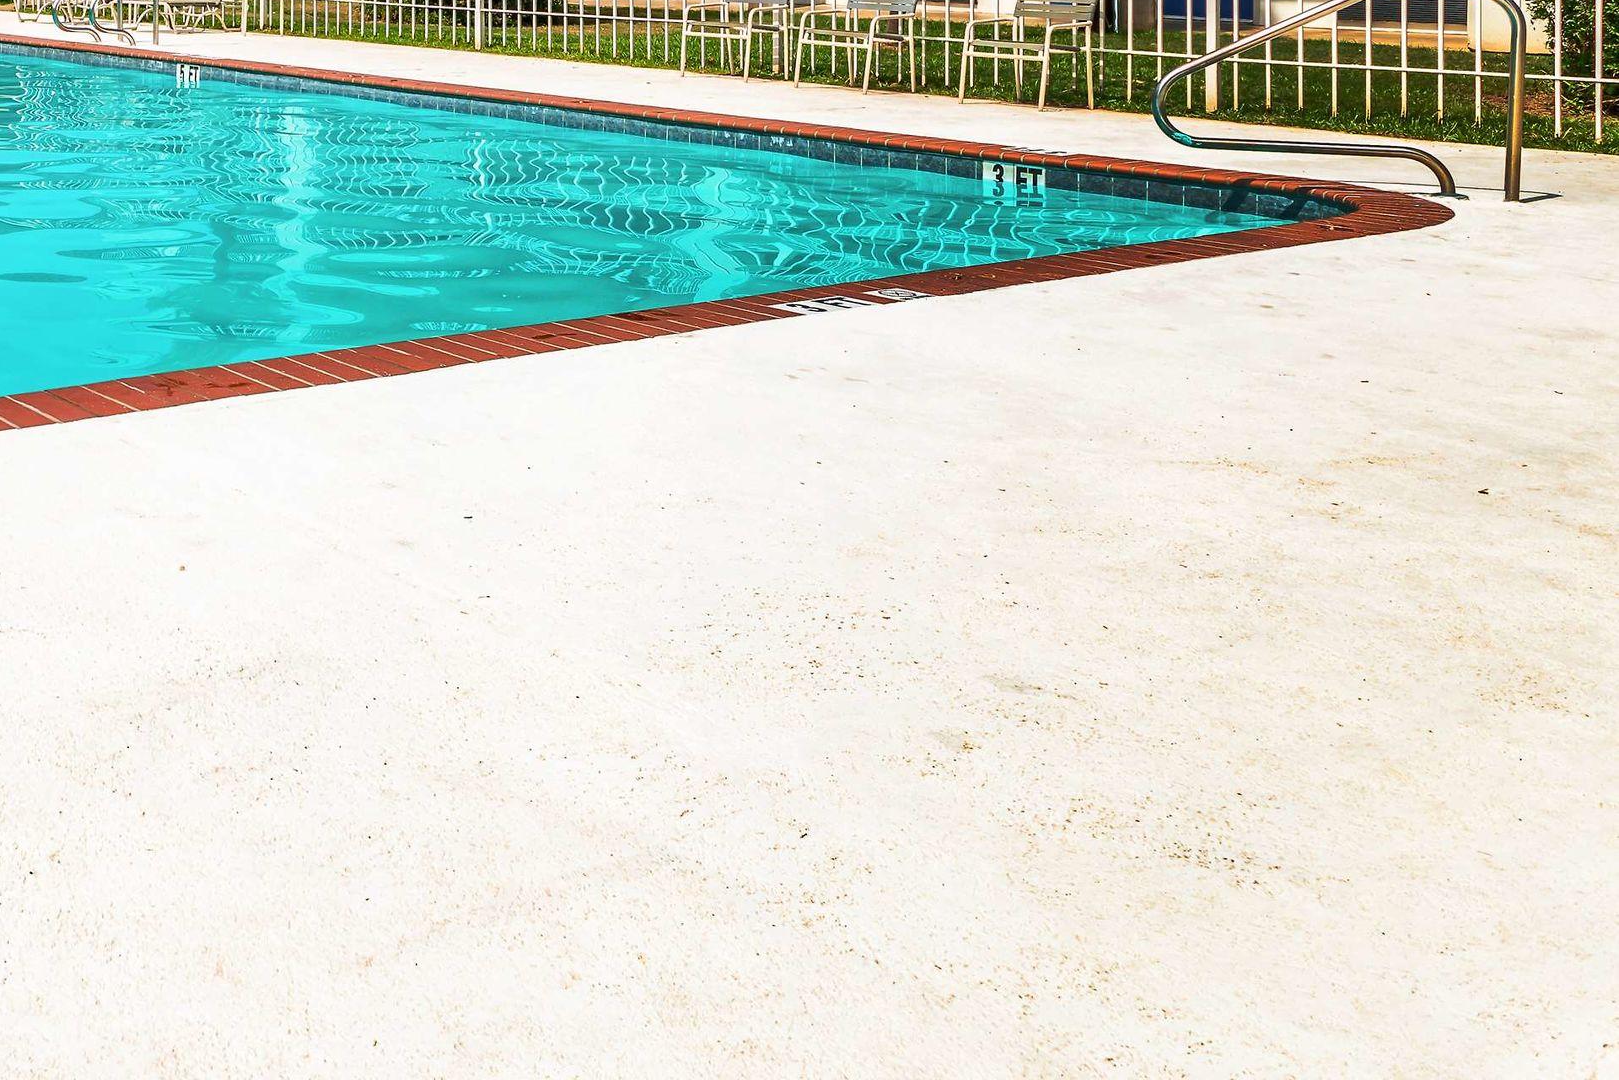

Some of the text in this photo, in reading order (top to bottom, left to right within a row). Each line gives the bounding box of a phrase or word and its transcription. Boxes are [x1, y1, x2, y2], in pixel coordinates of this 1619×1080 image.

[992, 164, 1004, 186] 3
[786, 297, 872, 313] 3 FT
